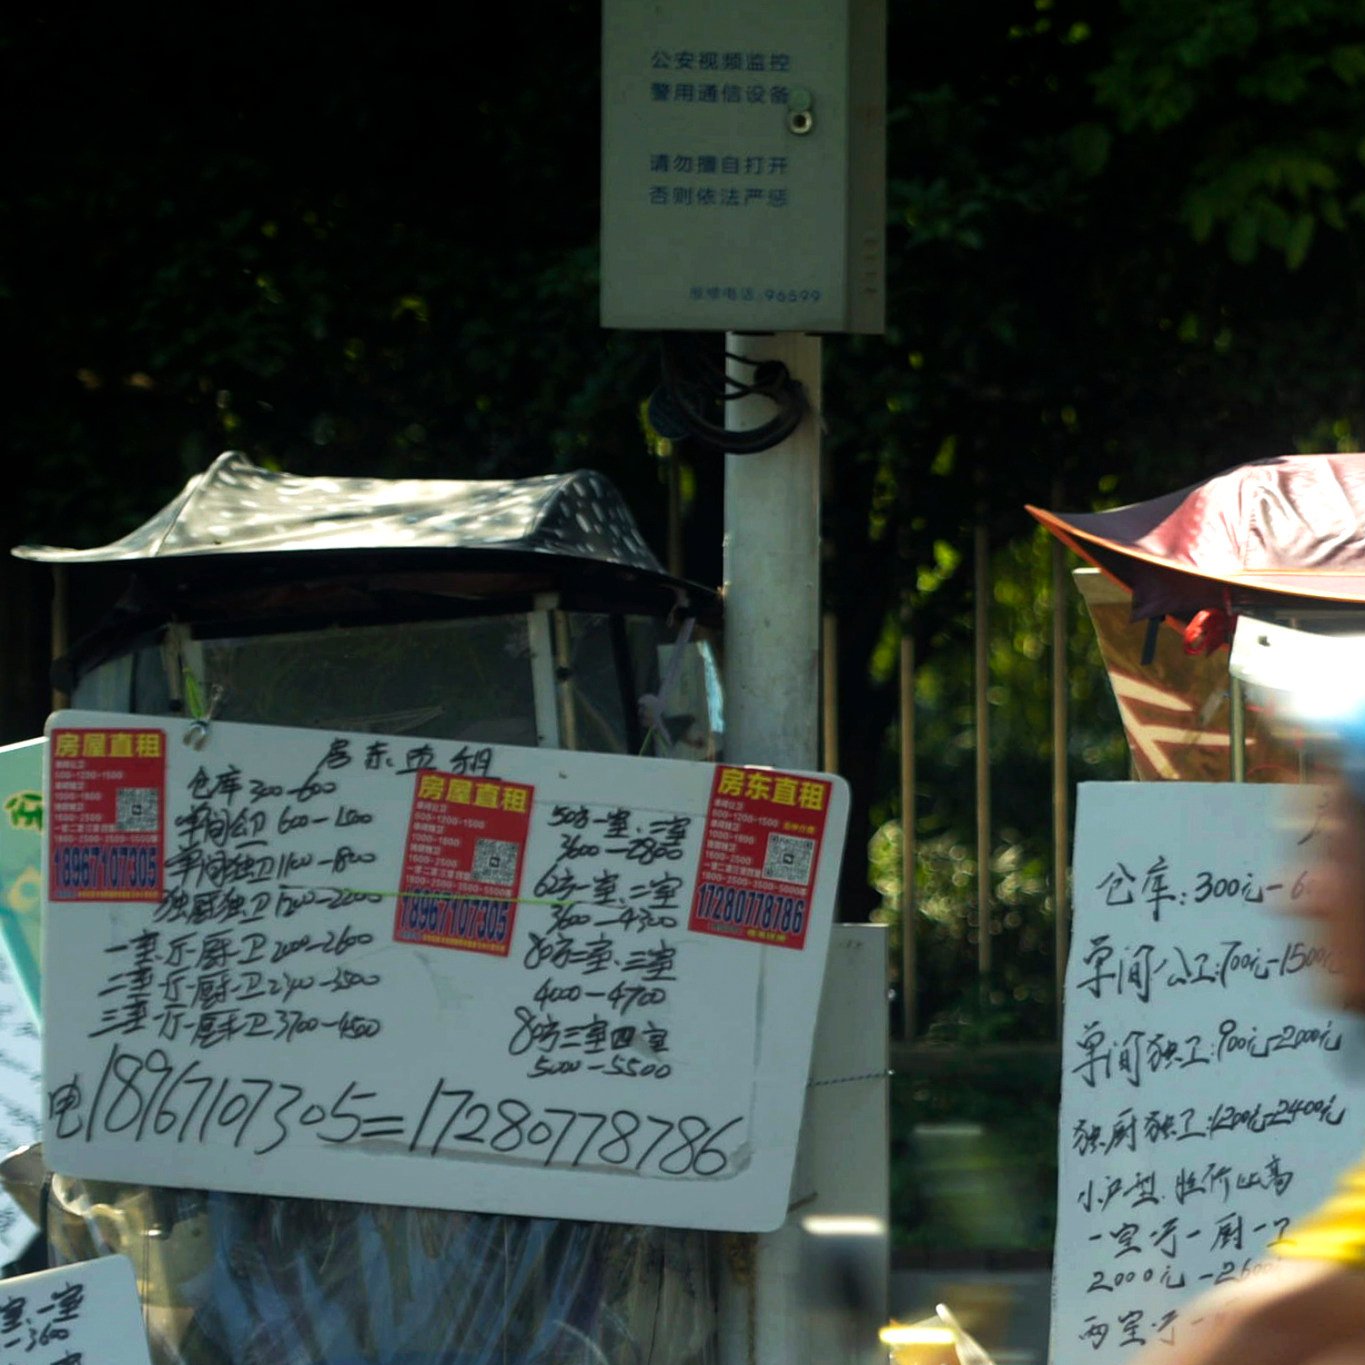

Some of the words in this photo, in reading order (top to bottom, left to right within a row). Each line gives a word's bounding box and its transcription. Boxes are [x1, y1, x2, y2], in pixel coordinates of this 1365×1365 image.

[651, 52, 791, 72] 公安视频监控
[651, 83, 789, 104] 警用通信设备
[651, 154, 787, 175] 请勿擅自打开
[649, 186, 788, 208] 否则依法严惩
[418, 775, 527, 814] 房屋直租
[718, 769, 825, 811] 房东直租
[54, 845, 158, 888] 18967107305
[401, 889, 509, 941] 18967107305
[698, 883, 805, 933] 17280778786
